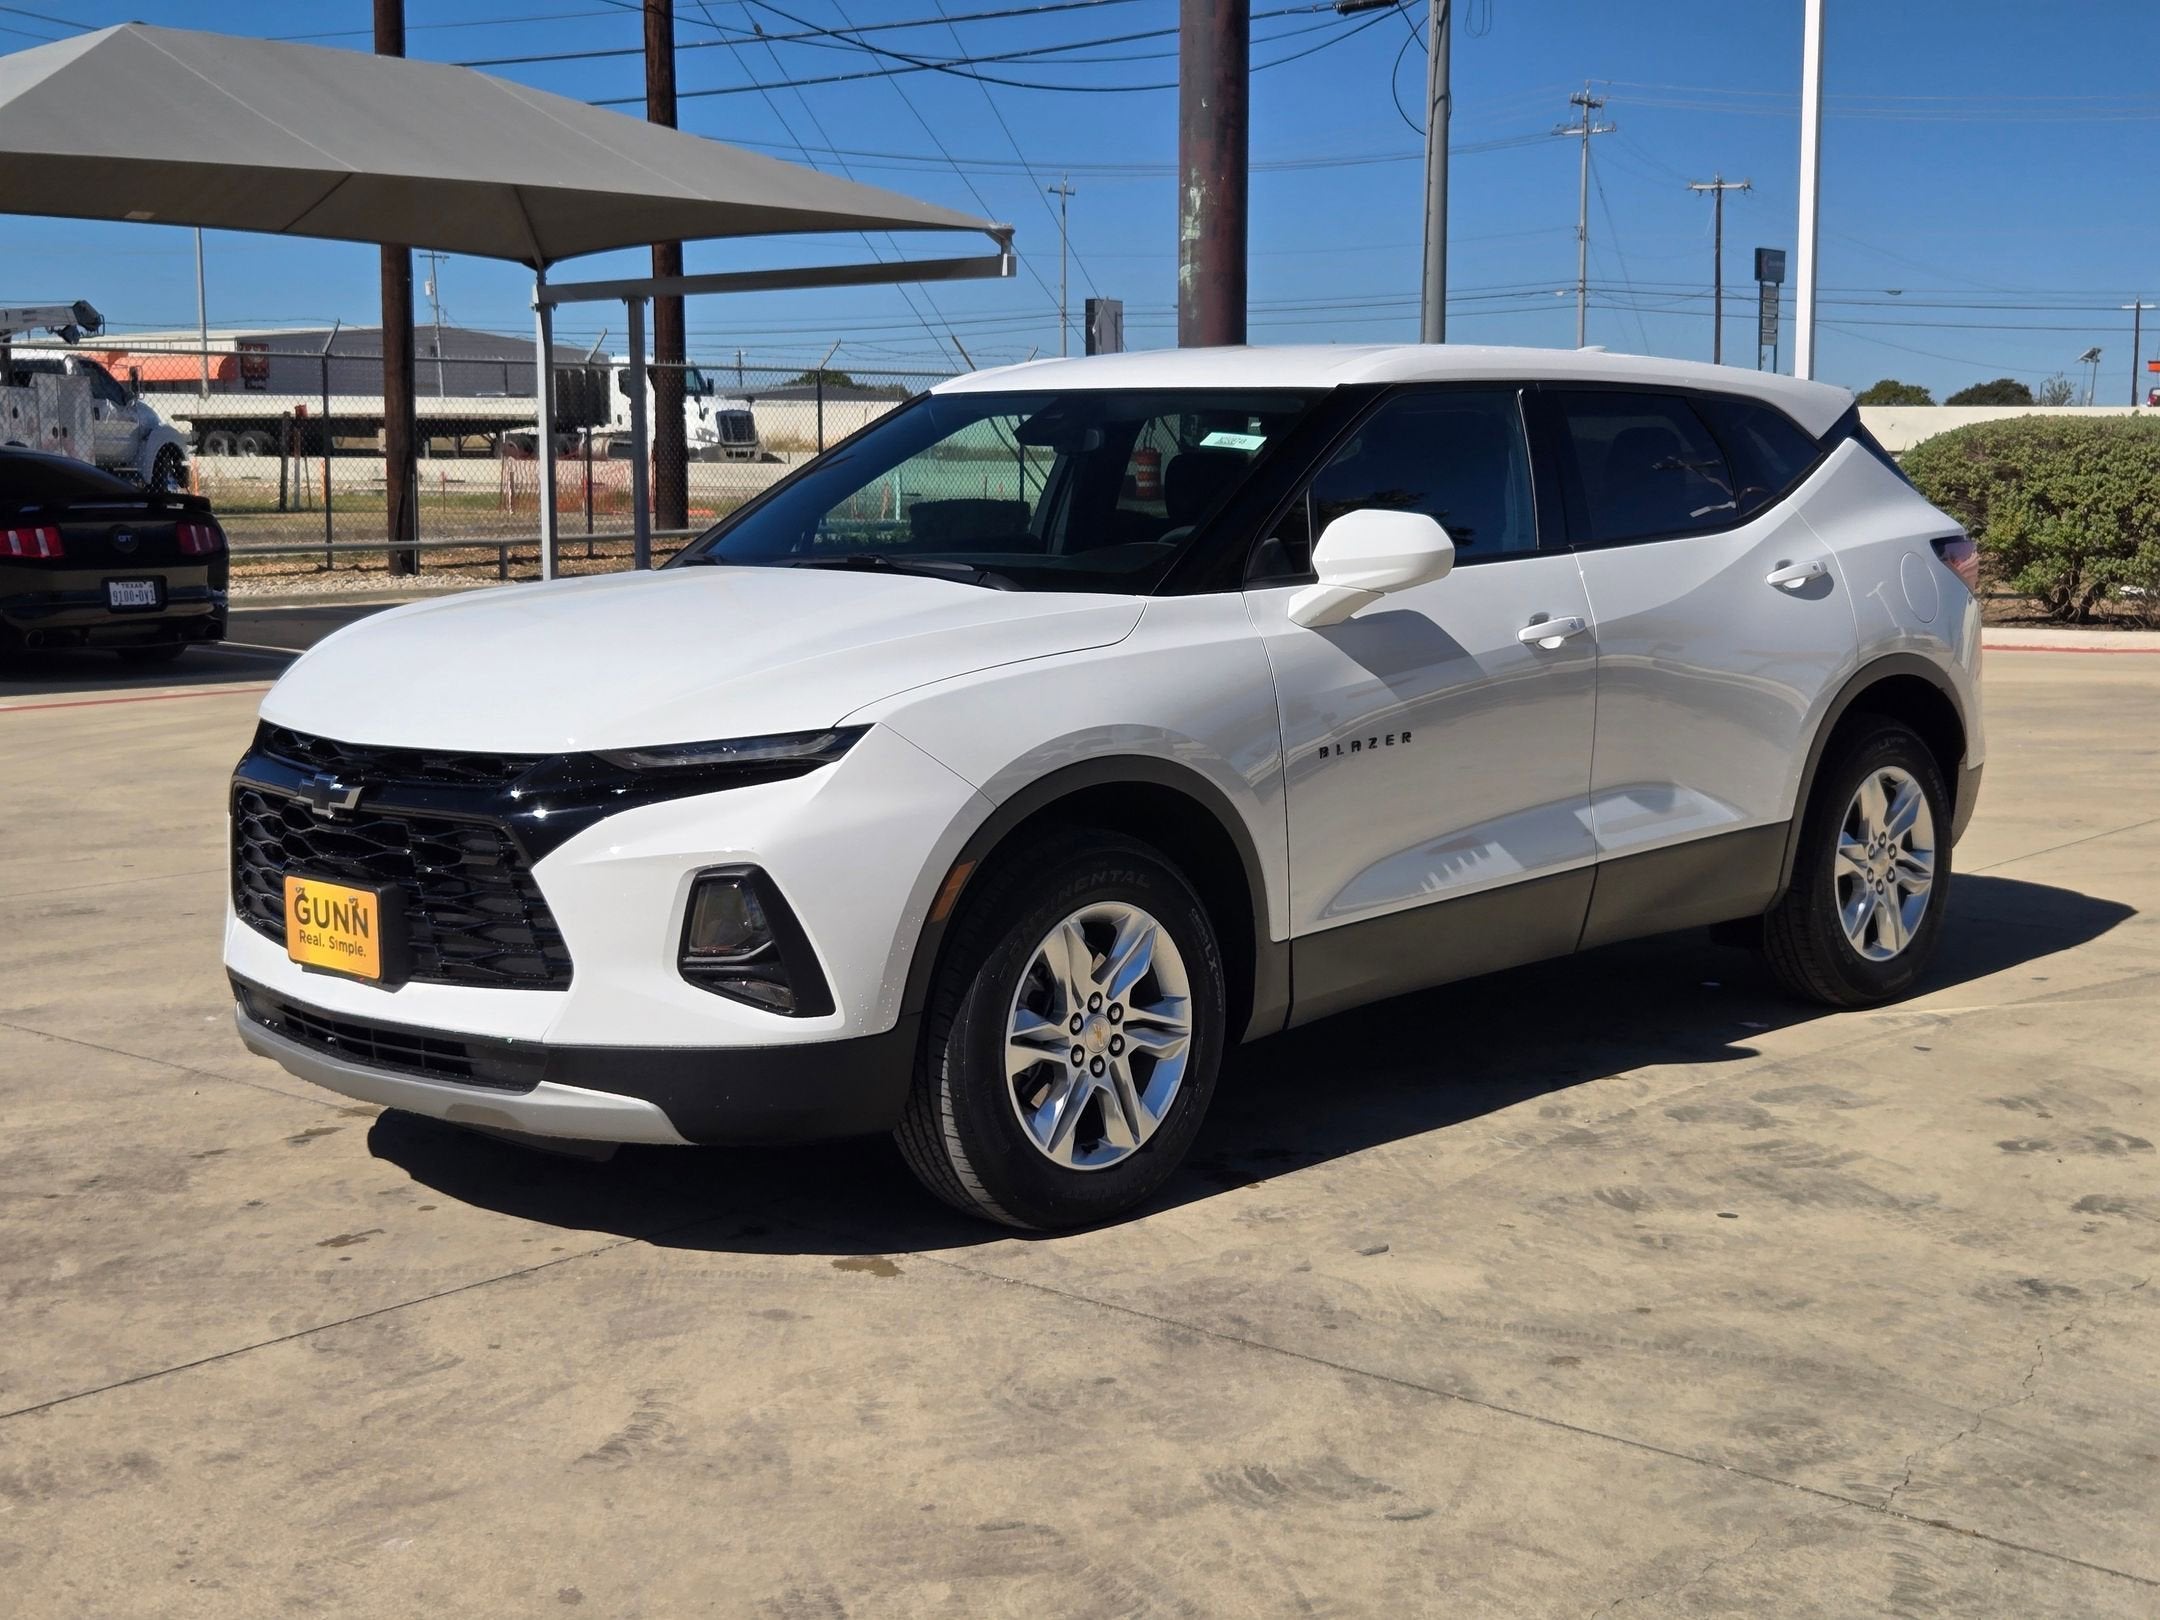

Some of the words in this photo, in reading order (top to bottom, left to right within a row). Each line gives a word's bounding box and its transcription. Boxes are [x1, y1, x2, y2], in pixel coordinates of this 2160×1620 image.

[1319, 731, 1412, 759] BLAZER
[294, 893, 369, 939] GUNN
[299, 929, 325, 948] Real.
[328, 935, 367, 958] Simple.
